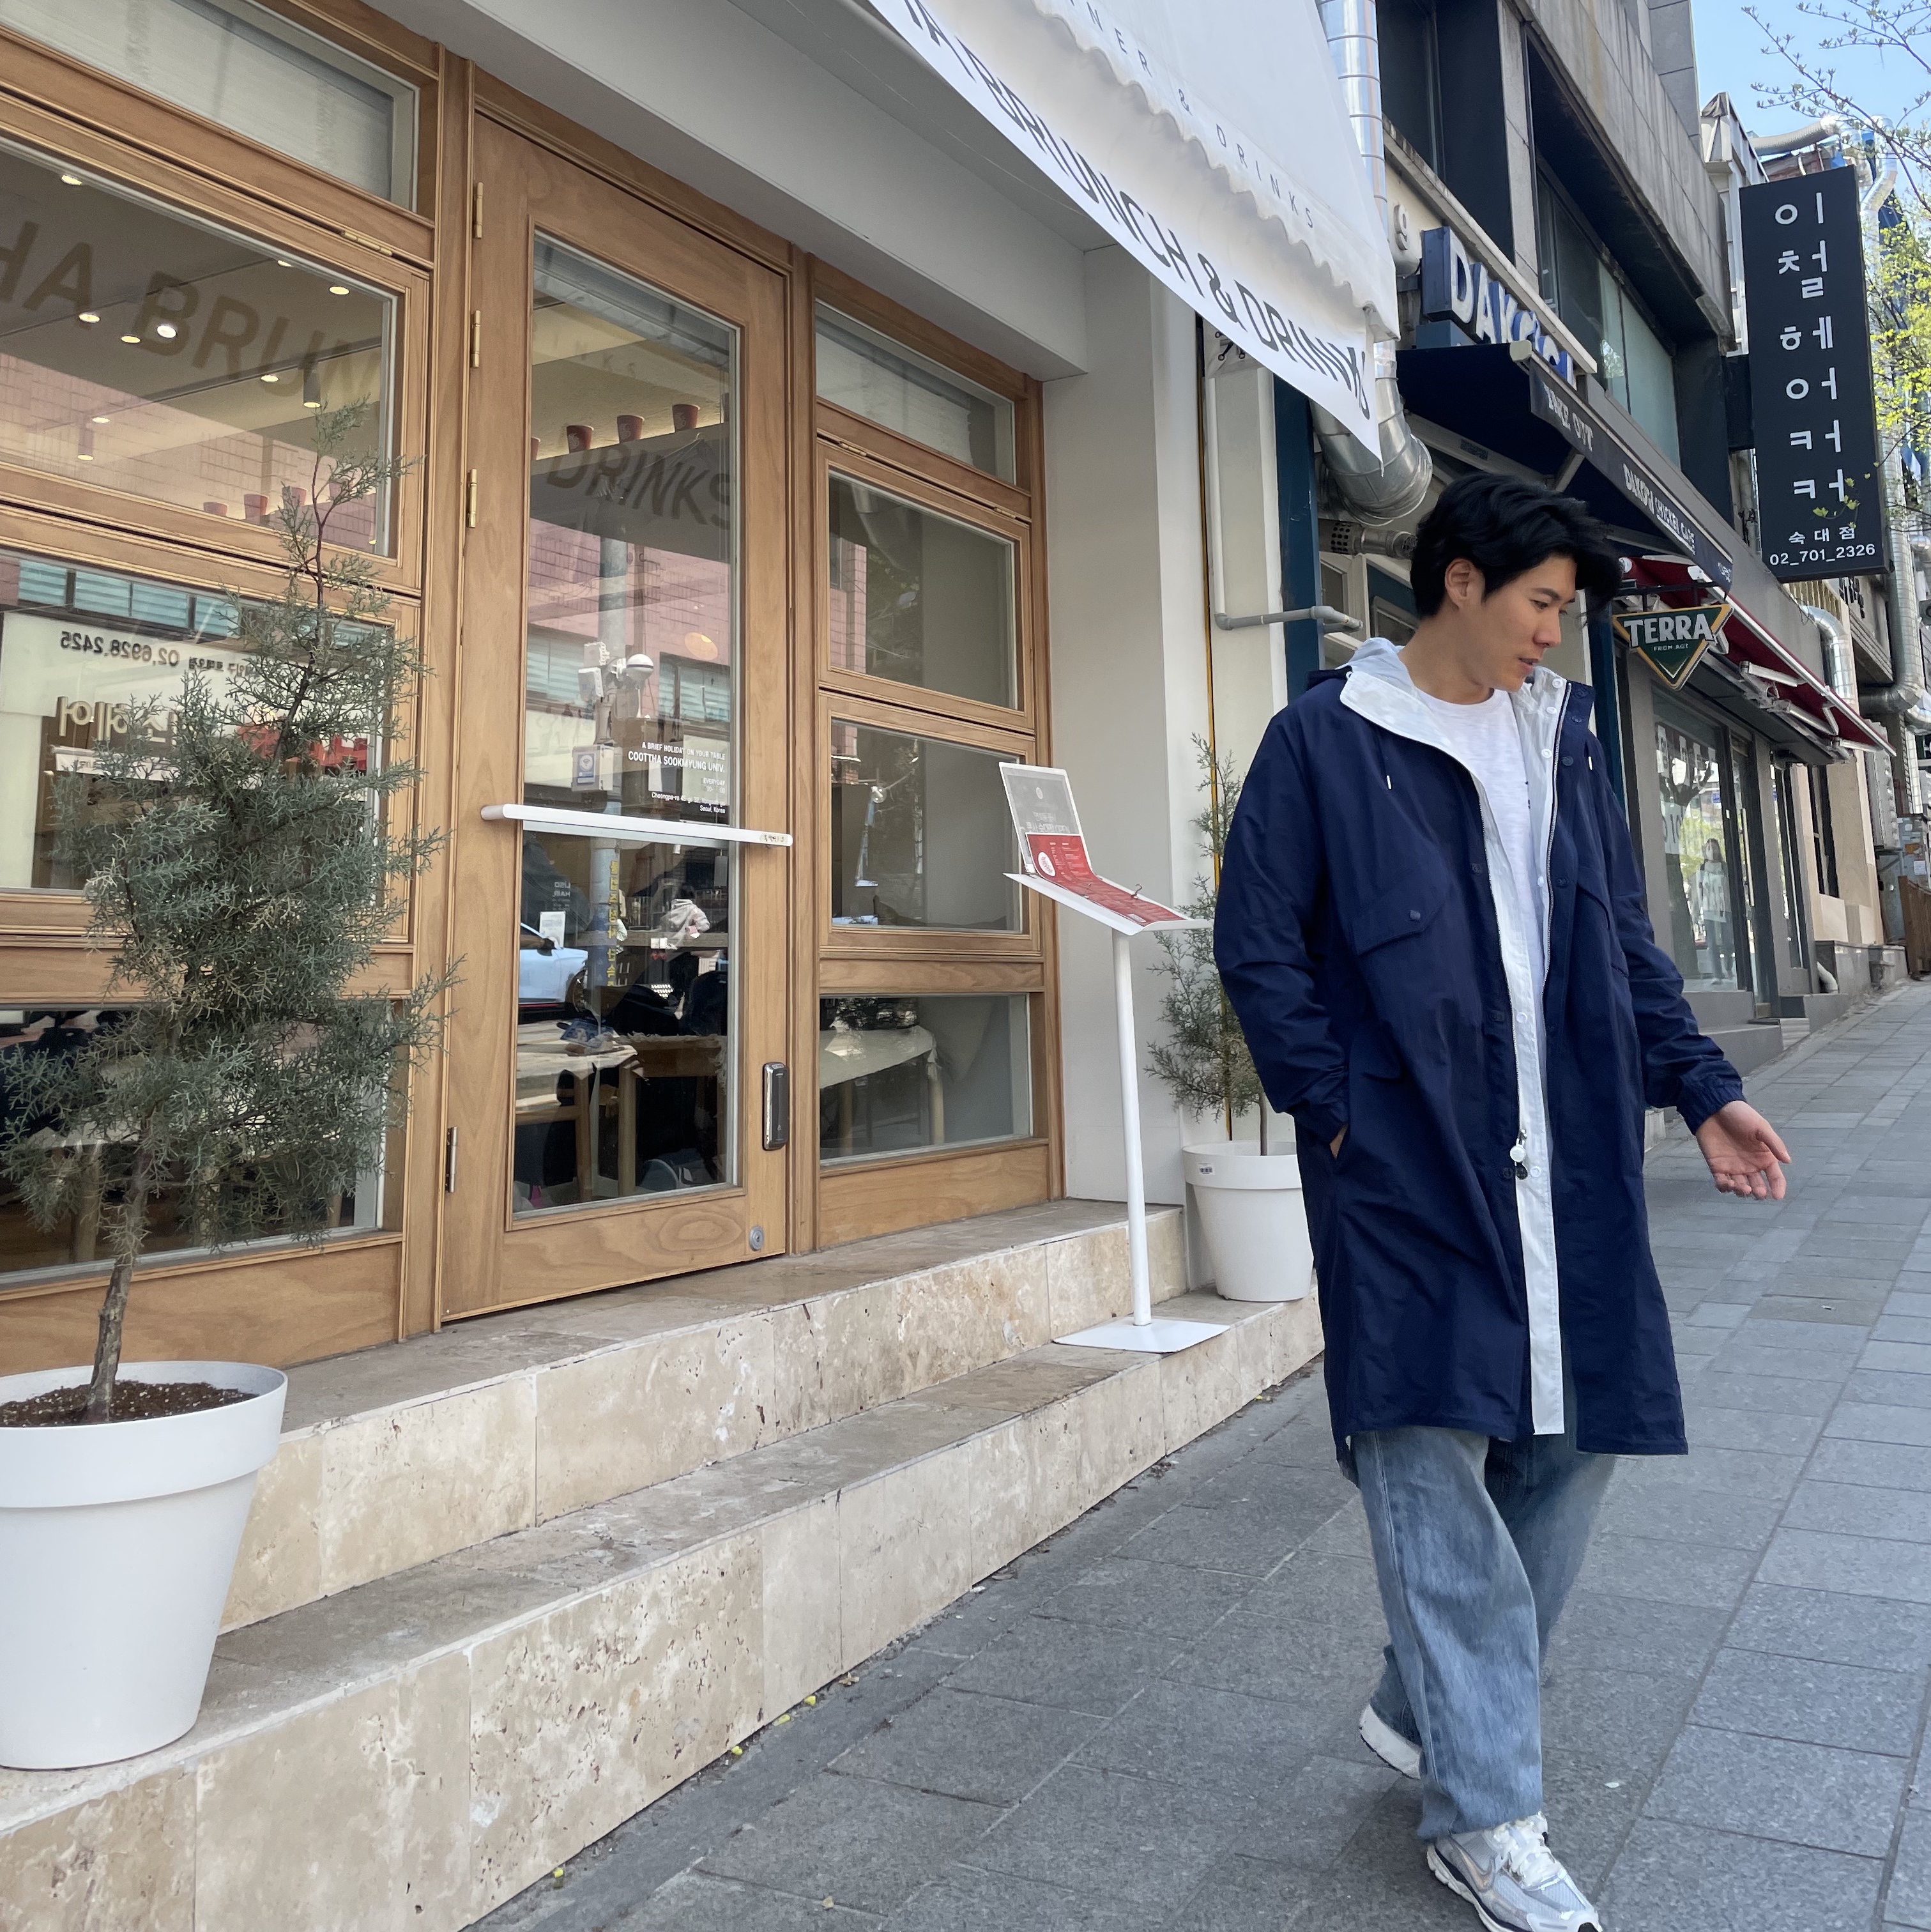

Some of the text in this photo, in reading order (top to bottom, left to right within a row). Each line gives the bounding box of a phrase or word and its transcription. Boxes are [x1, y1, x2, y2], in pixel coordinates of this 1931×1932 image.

[1070, 0, 1152, 78] NER
[1216, 124, 1313, 229] DRINKS
[954, 35, 1203, 298] BRUNCH
[1237, 281, 1370, 420] DRINKS
[1775, 192, 1845, 502] 이철헤어커커
[1789, 526, 1855, 544] 숙대점
[1769, 544, 1875, 566] 02_701_2326
[1624, 613, 1716, 647] TERRA
[628, 751, 726, 773] COOTTHA SOOKMYUNG UNIV.
[642, 741, 646, 749] A
[664, 745, 685, 754] HOLIDAY
[711, 752, 726, 760] TABLE
